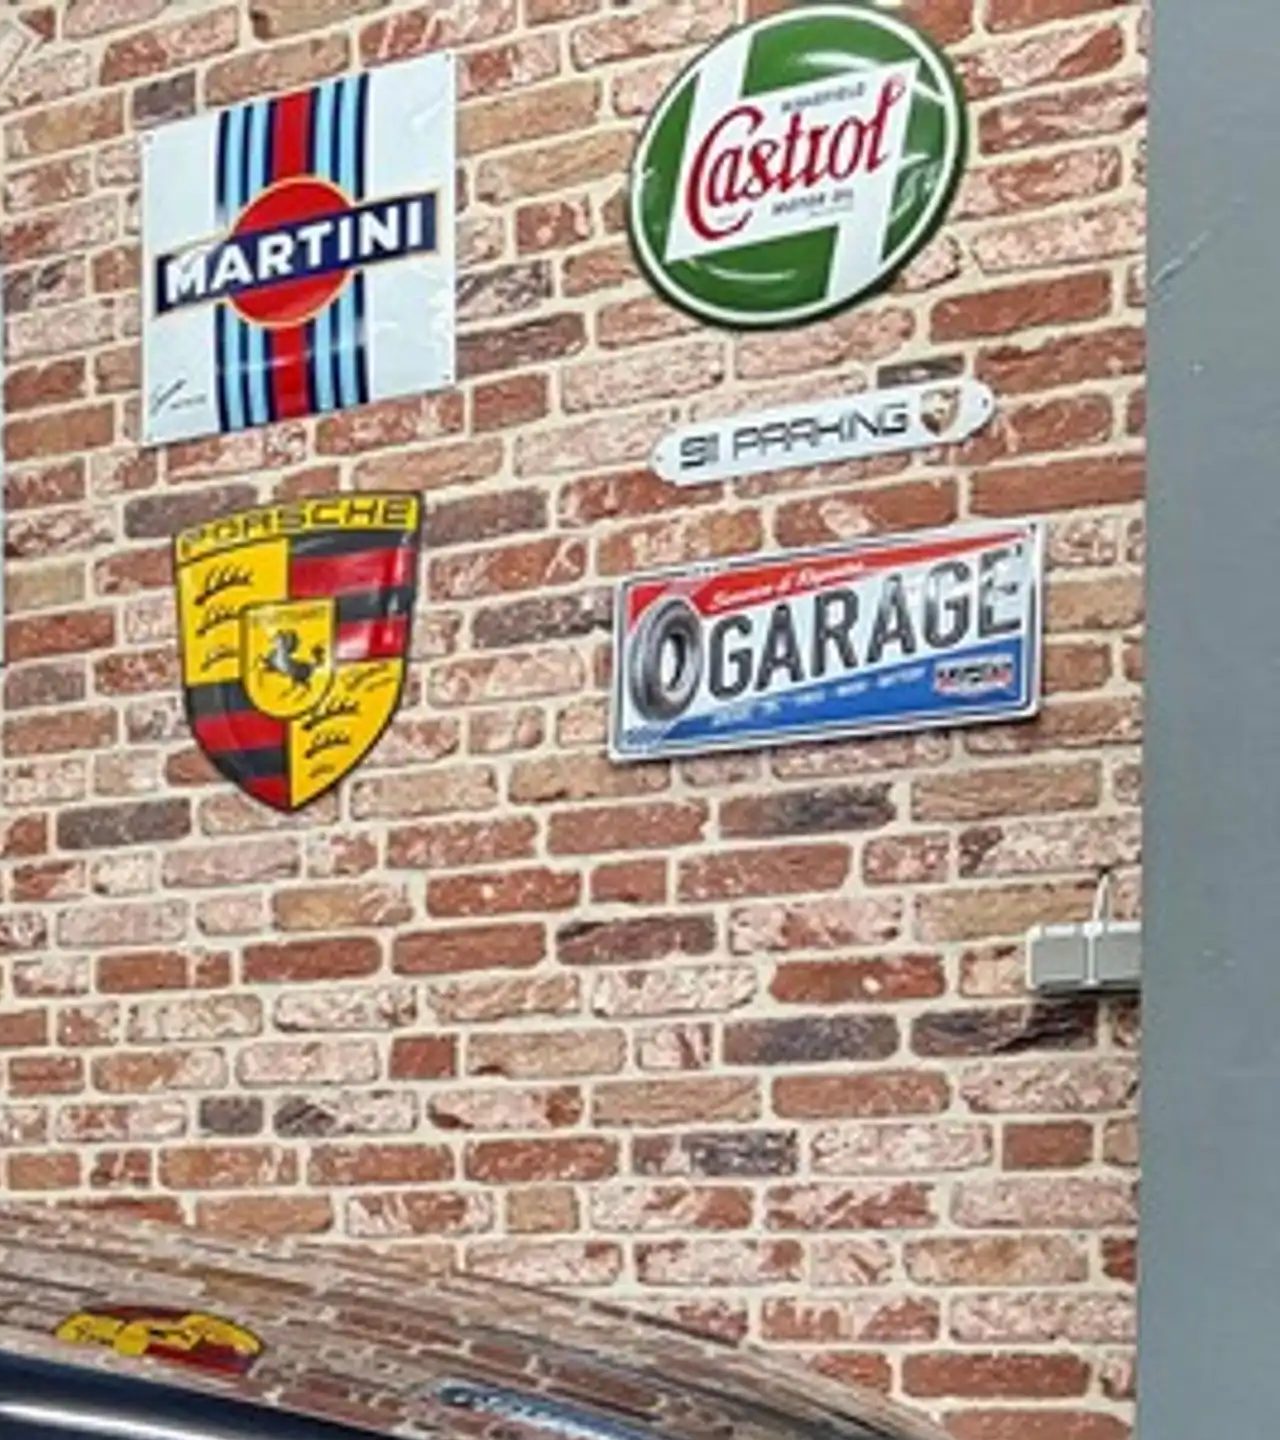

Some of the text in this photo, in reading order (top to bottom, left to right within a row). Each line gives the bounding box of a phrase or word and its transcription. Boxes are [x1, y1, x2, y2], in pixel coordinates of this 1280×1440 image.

[686, 73, 907, 242] Castrol
[165, 200, 423, 305] MARTINI
[732, 402, 908, 463] PARKING
[180, 497, 410, 557] PORSCHE
[708, 544, 1023, 702] GARAGE
